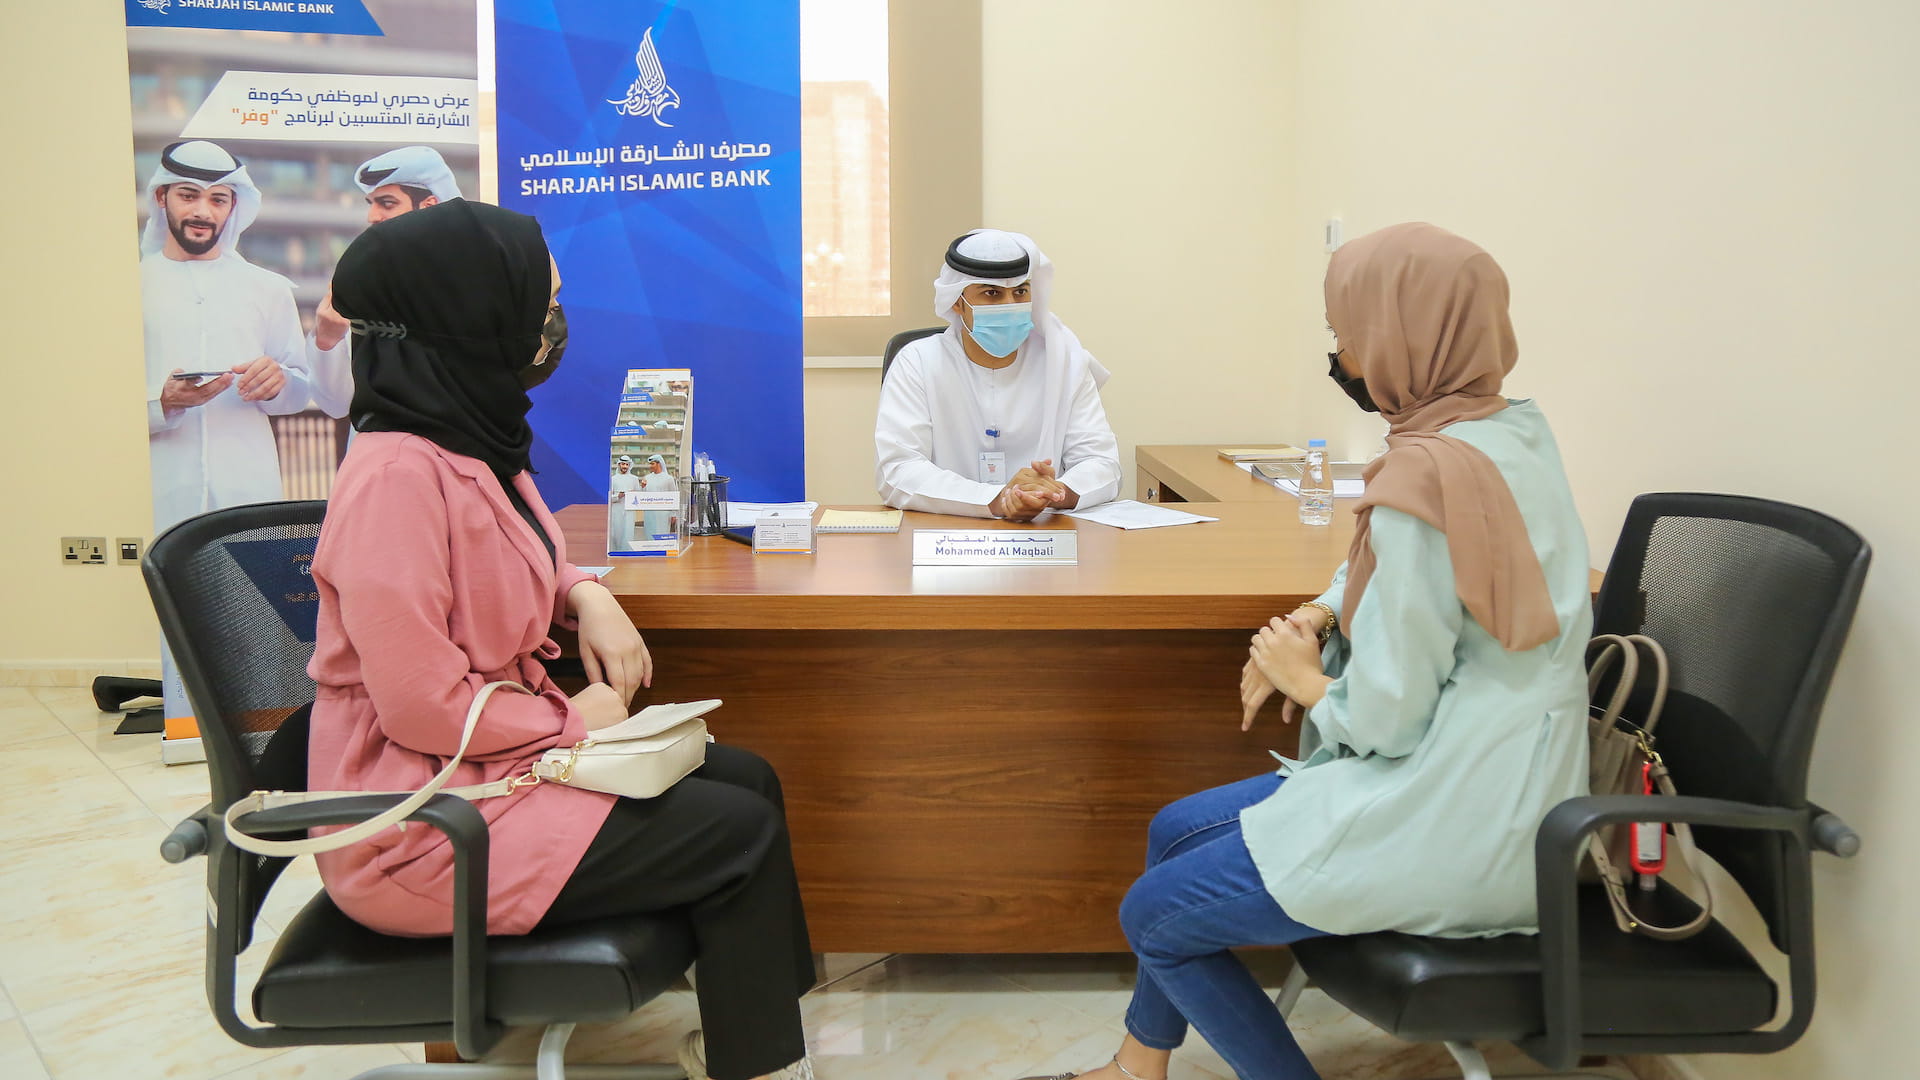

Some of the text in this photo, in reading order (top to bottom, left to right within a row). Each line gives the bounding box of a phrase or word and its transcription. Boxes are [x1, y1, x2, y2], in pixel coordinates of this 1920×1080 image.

[178, 0, 240, 10] SHARJAH
[243, 0, 294, 13] ISLAMIC
[298, 3, 335, 14] BANK
[247, 87, 471, 110] عرض حصري لموظفي حكومة
[284, 110, 334, 126] لبرنامج
[338, 112, 412, 128] المنتسبين
[416, 111, 470, 129] الشارقة
[520, 139, 772, 172] مصرف الشارقة الإسلامي
[520, 168, 771, 196] SHARJAH ISLAMIC BANK
[935, 546, 1054, 557] Mohammed Al Maqbali
